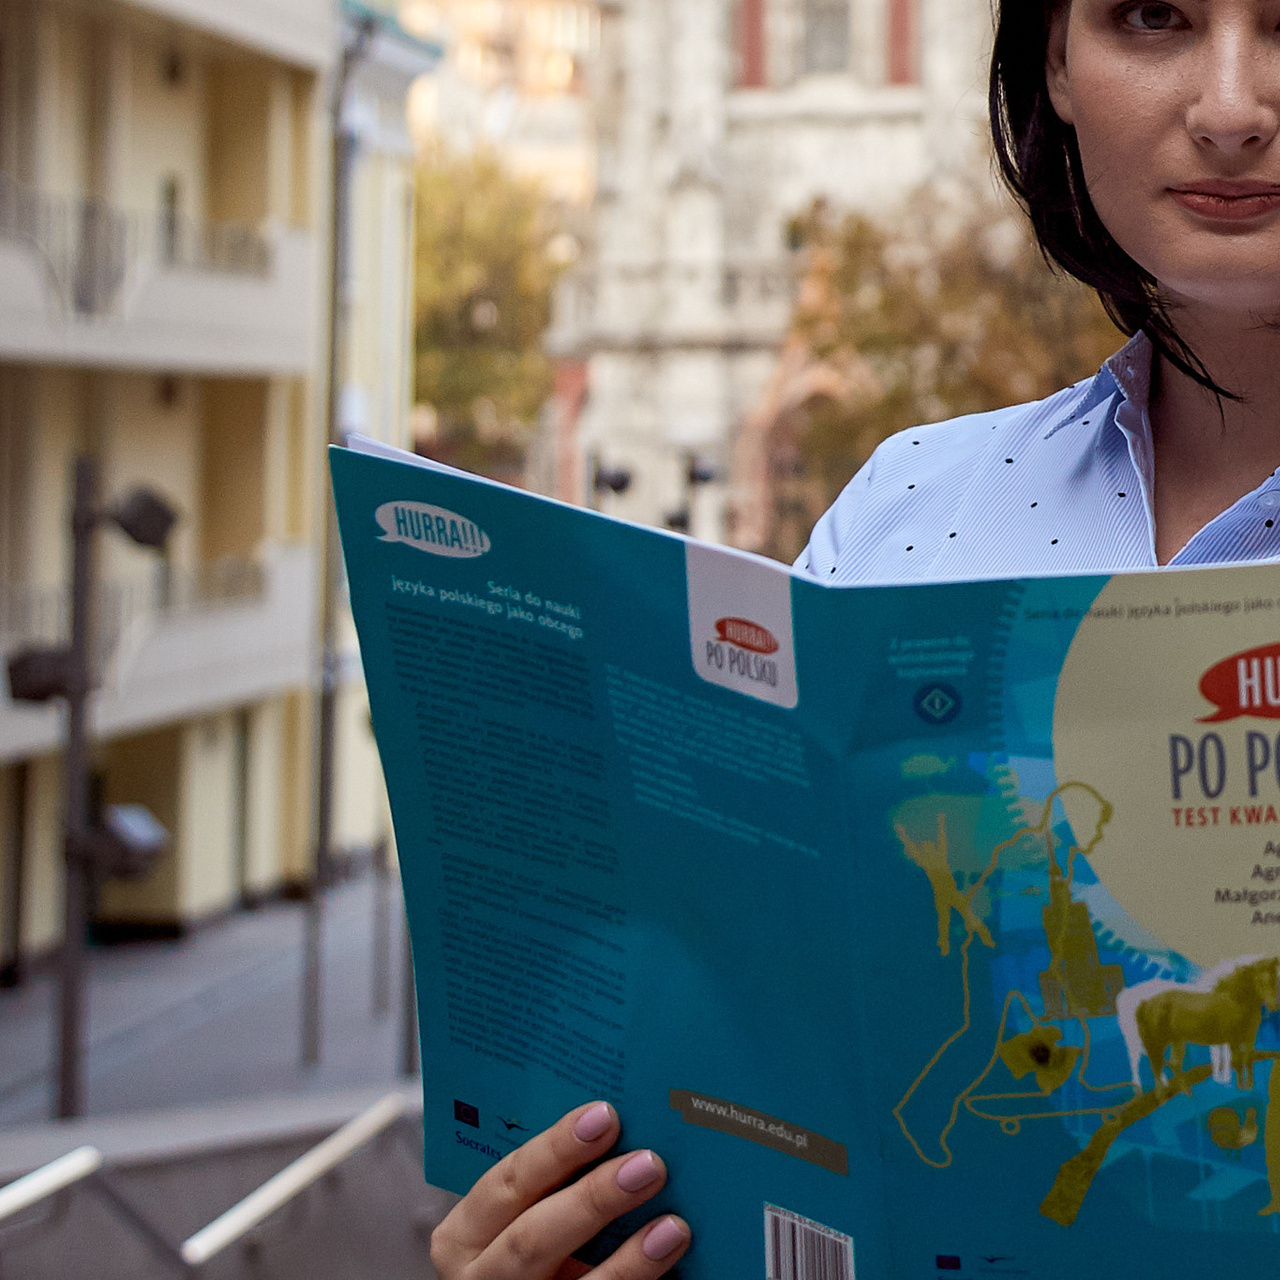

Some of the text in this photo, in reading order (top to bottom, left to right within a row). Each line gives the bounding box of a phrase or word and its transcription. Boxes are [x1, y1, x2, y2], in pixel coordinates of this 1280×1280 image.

[393, 506, 486, 554] HURRA!!!
[391, 574, 583, 638] języka polskiego jako obcego
[486, 580, 581, 619] Seria do nauki
[706, 640, 777, 688] PO POLSKU
[1169, 732, 1226, 800] PO
[1172, 807, 1221, 828] TEST
[691, 1096, 808, 1147] www.hurra.edu.pl
